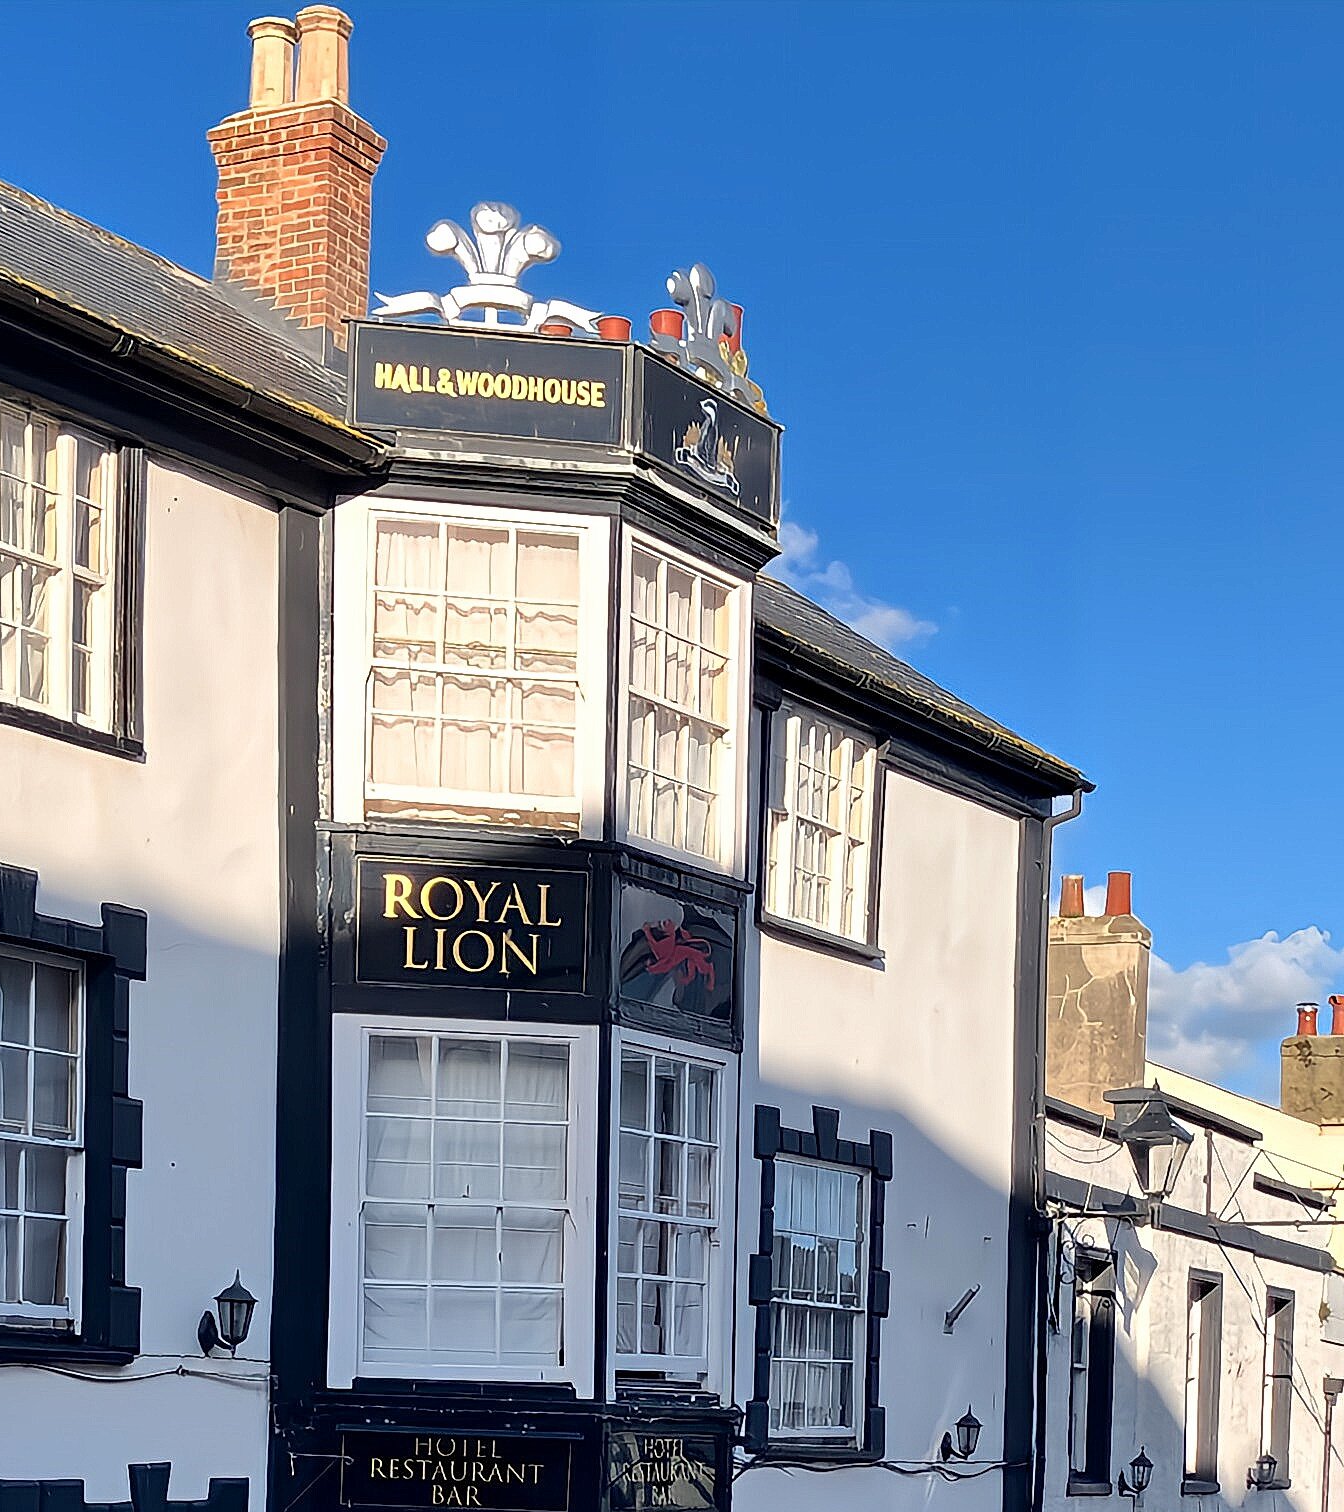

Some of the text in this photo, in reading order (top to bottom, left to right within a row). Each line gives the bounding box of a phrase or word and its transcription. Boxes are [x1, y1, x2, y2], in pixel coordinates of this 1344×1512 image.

[374, 361, 606, 408] HALL&WOODHOUSE
[382, 873, 562, 927] ROYAL
[402, 926, 541, 975] LION
[415, 1437, 502, 1459] HOTEL
[644, 1438, 683, 1459] HOTEL
[371, 1457, 545, 1485] RESTAURANT
[432, 1484, 482, 1506] BAR
